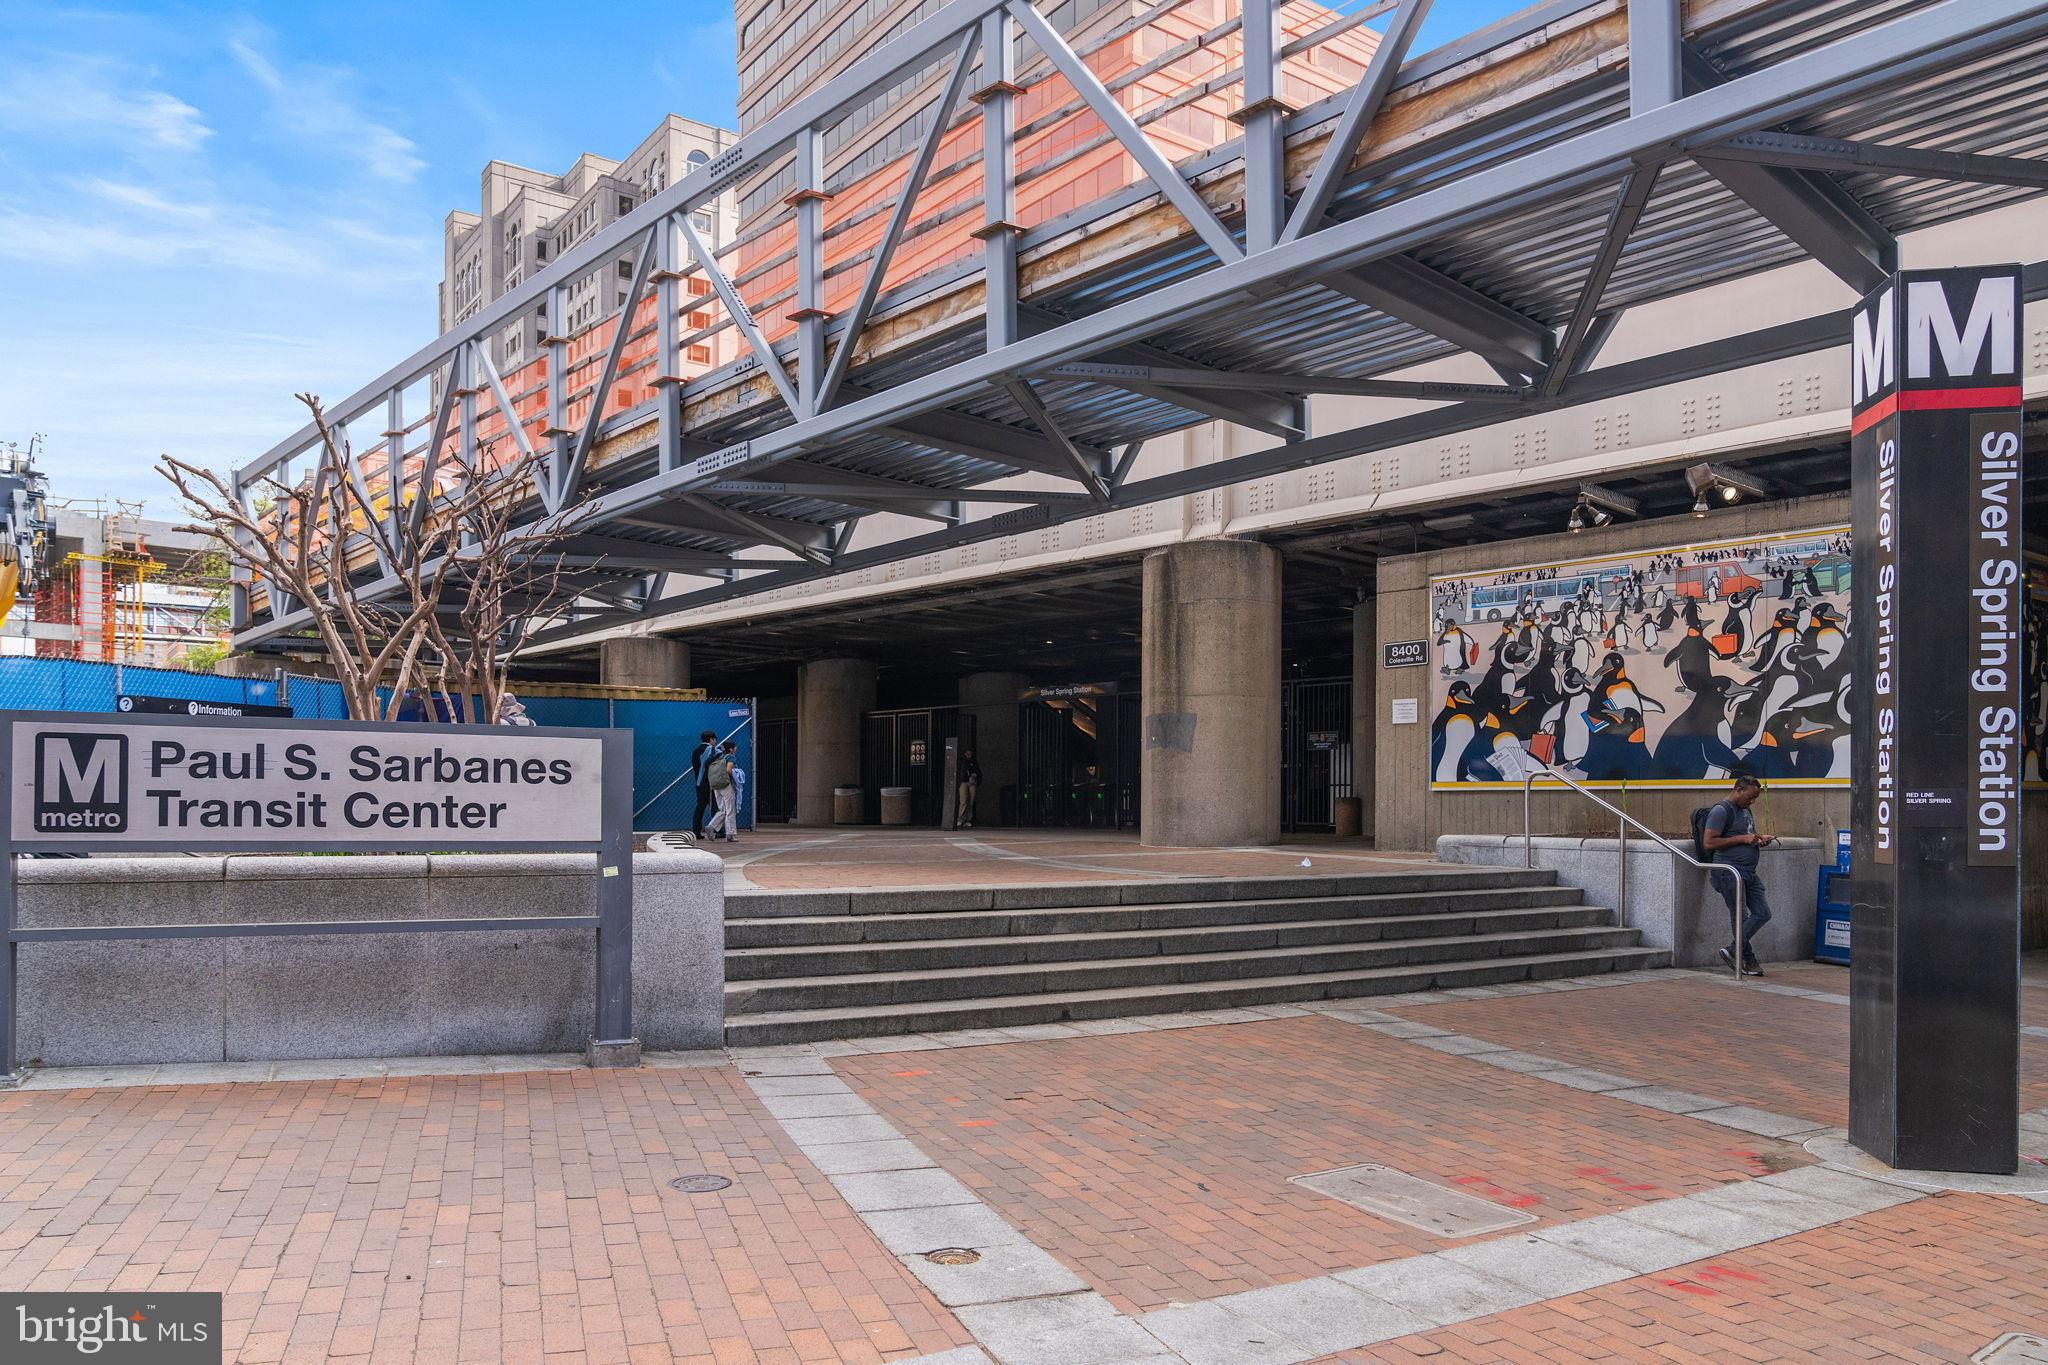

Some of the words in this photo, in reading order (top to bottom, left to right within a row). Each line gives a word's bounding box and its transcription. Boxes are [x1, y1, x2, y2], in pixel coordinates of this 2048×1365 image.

[1853, 286, 1894, 407] M
[1907, 276, 2015, 379] M
[1879, 439, 1895, 553] Silver
[1981, 431, 2018, 547] Silver
[1388, 656, 1414, 664] Colesville
[1391, 644, 1420, 657] 8400
[1876, 564, 1895, 695] Spring
[1971, 559, 2018, 692] Spring
[198, 705, 242, 717] Information
[1040, 688, 1055, 696] Silver
[1055, 687, 1073, 696] Spring
[1073, 686, 1092, 694] Station
[43, 738, 120, 804] M
[151, 740, 265, 780] Paul
[283, 743, 331, 781] S.
[348, 745, 572, 785] Sarbanes
[1878, 707, 1894, 850] Station
[1979, 706, 2017, 851] Station
[41, 809, 120, 828] metro
[146, 789, 327, 828] Transit
[343, 791, 507, 829] Center
